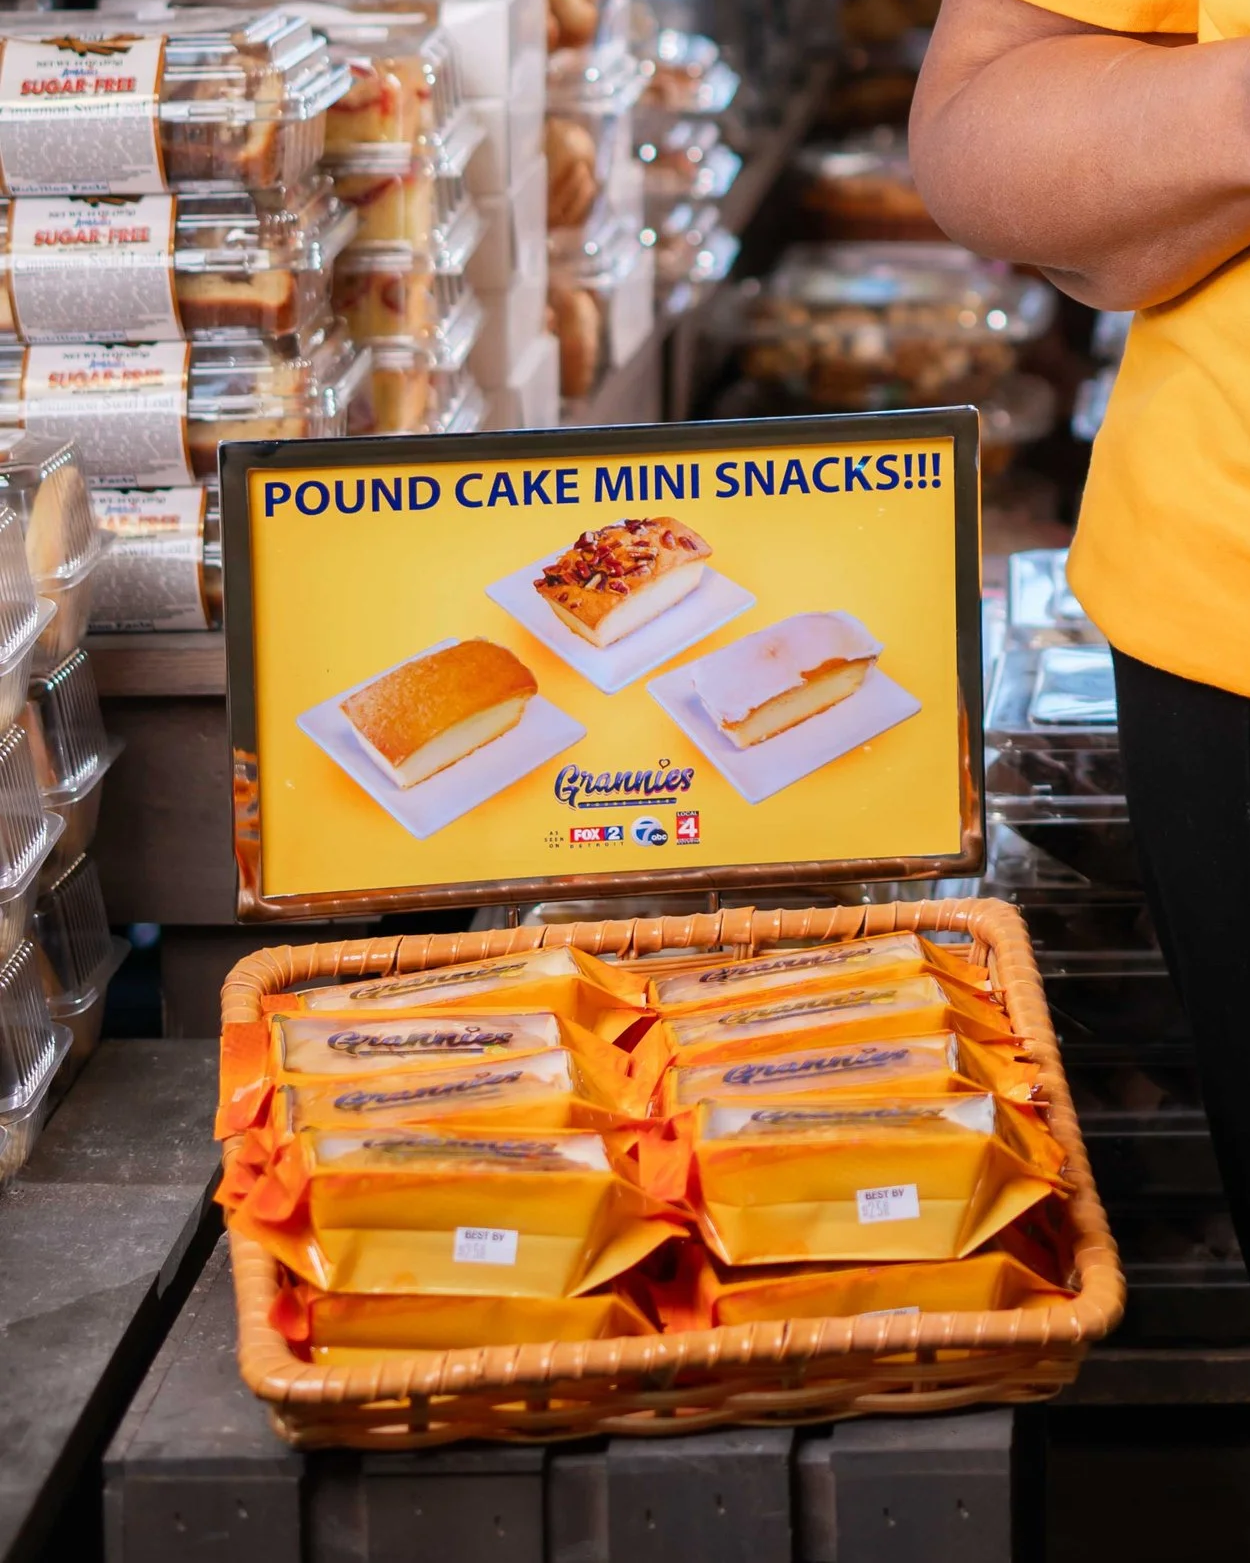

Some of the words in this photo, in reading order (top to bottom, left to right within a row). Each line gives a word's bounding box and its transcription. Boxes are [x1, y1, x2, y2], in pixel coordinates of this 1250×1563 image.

[20, 76, 137, 96] SUGAR-FREE
[33, 226, 151, 247] SUGAR-FREE
[264, 475, 441, 518] POUND
[454, 467, 580, 508] CAKE
[594, 463, 700, 503] MINI
[715, 452, 943, 499] SNACKS!!!
[553, 758, 695, 811] Grannies
[573, 828, 601, 841] FOX
[607, 826, 621, 841] 2
[651, 833, 668, 841] abc
[677, 817, 699, 838] 4
[569, 841, 624, 849] DETROIT
[327, 1024, 514, 1058] Grannies
[722, 1046, 910, 1084] Grannies
[864, 1189, 889, 1201] BEST
[891, 1187, 905, 1198] BY
[464, 1229, 489, 1240] BEST
[491, 1231, 506, 1241] BY
